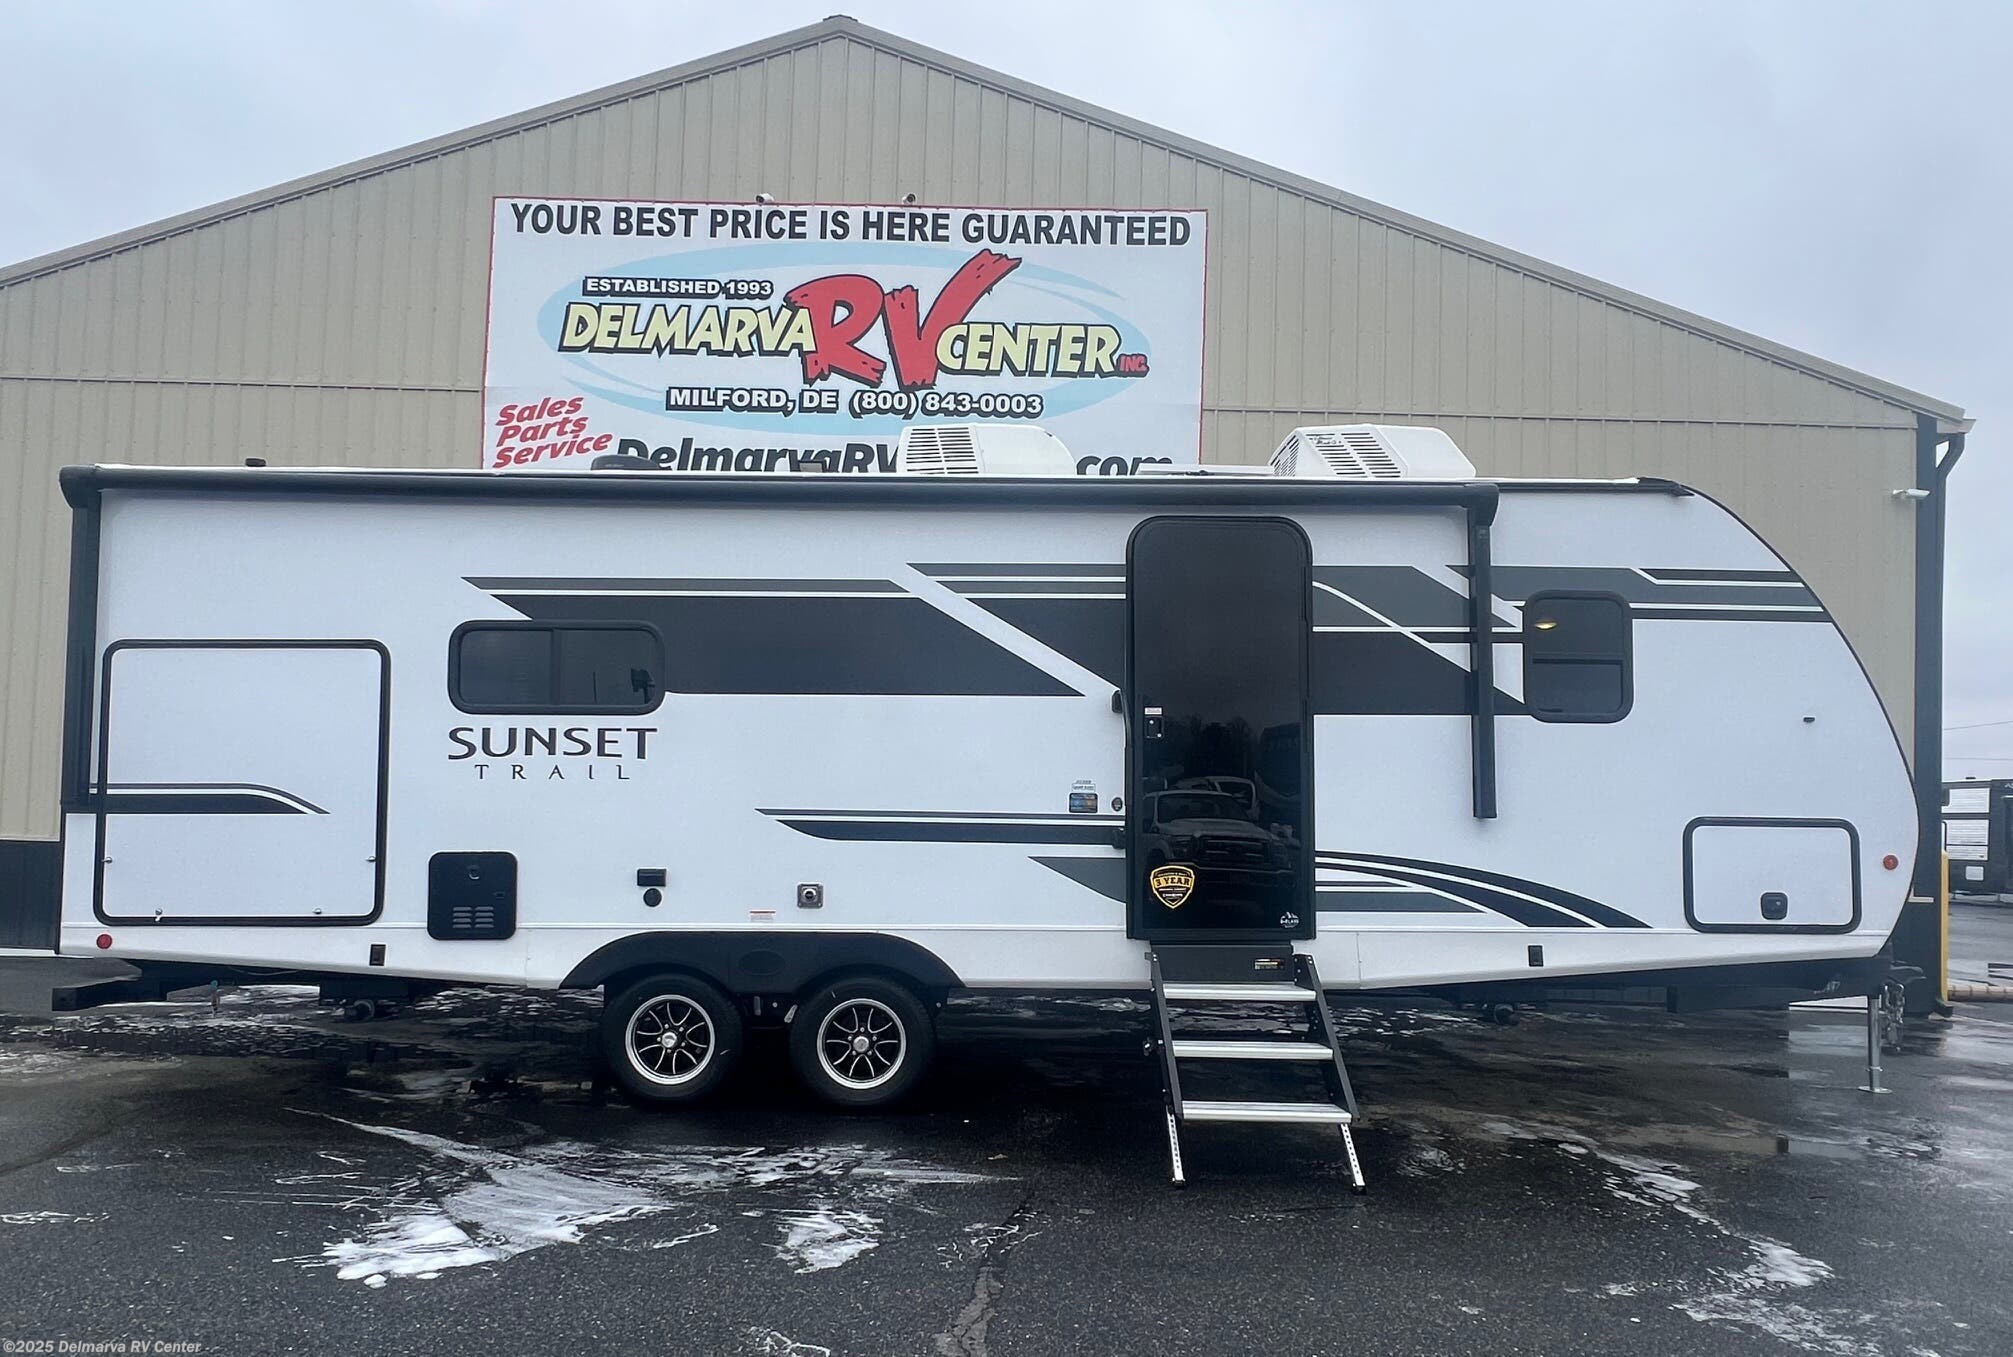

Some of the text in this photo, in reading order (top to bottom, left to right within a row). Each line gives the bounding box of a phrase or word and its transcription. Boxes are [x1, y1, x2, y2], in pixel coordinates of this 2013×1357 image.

[511, 203, 1191, 246] YOUR BEST PRICE IS HERE GUARANTEED
[584, 278, 774, 297] ESTABLISHED 1993
[560, 303, 817, 355] DELMARVA
[784, 249, 1022, 389] RV
[936, 323, 1121, 375] CENTER
[496, 397, 584, 426] Sales
[669, 387, 1042, 414] MILFORD, DE (800) 843-0003
[497, 416, 588, 447] Parts
[492, 433, 614, 469] Service
[448, 727, 658, 760] SUNSET
[474, 764, 630, 780] TRAIL
[1163, 876, 1190, 886] YEAR
